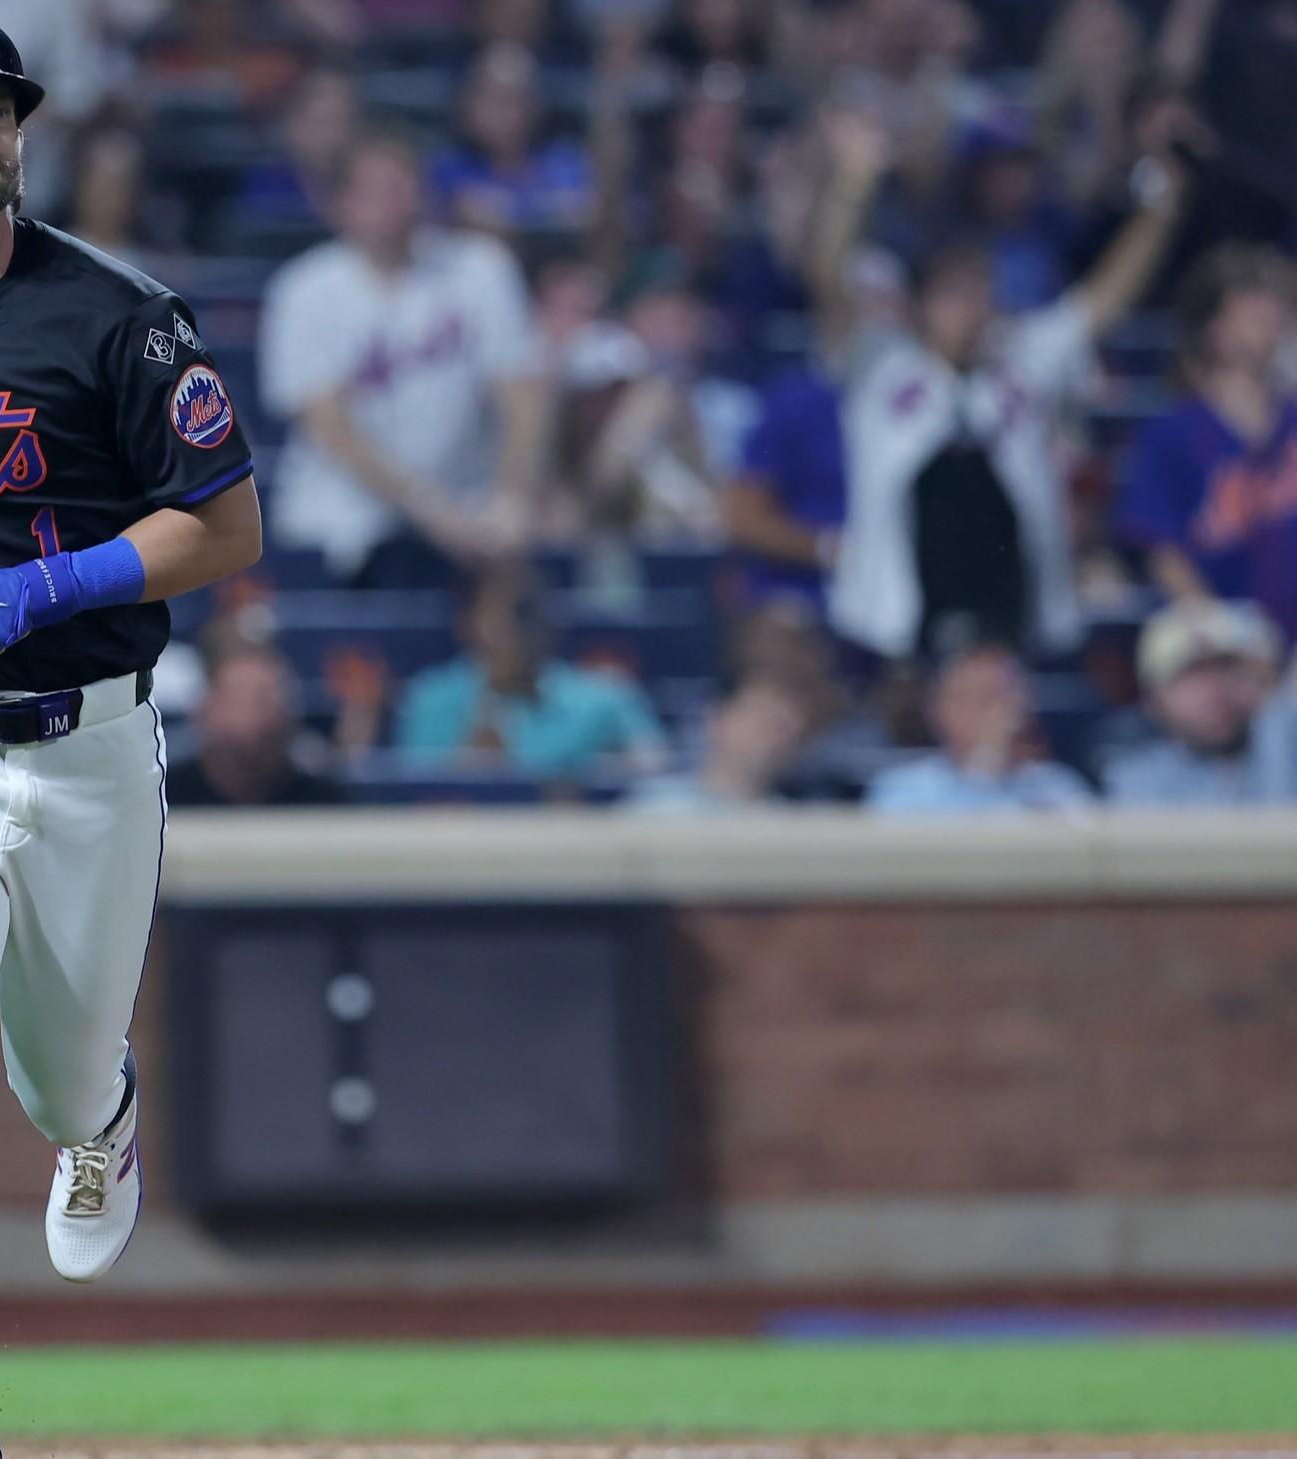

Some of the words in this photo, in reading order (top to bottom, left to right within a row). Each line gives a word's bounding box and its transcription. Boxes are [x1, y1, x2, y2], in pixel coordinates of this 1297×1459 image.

[186, 390, 222, 432] Mets
[31, 506, 60, 559] 1
[44, 714, 69, 736] JM
